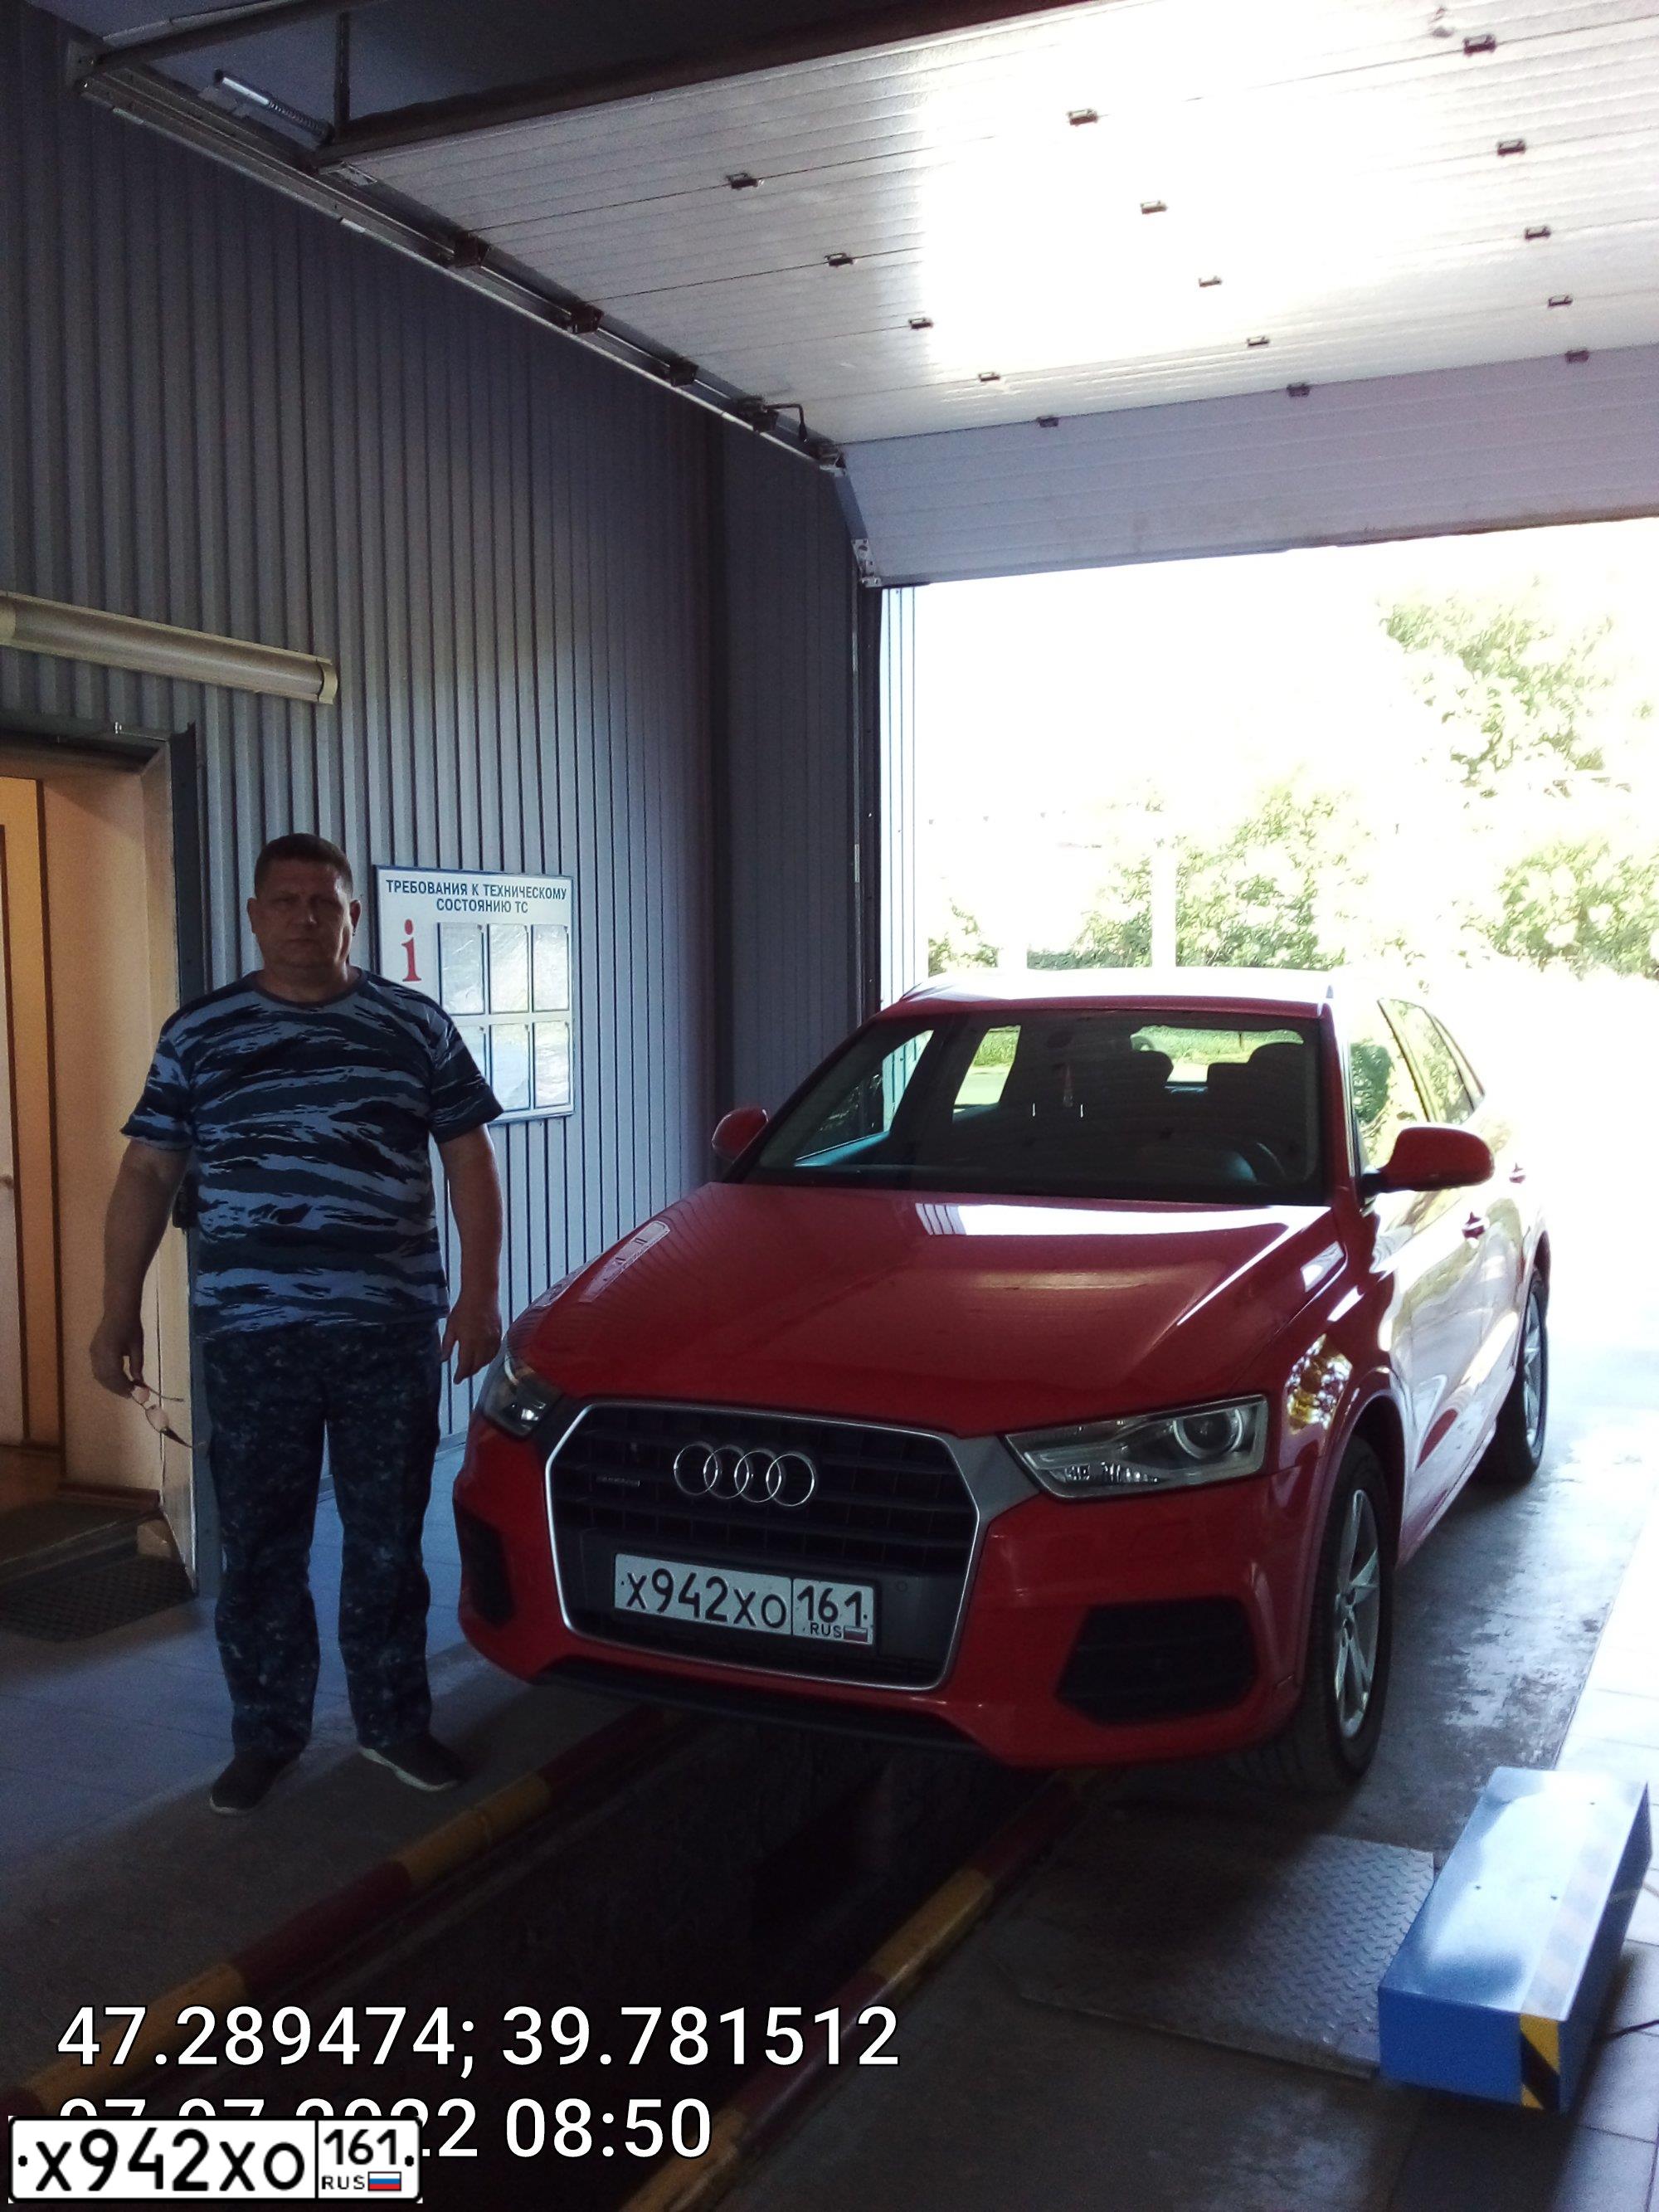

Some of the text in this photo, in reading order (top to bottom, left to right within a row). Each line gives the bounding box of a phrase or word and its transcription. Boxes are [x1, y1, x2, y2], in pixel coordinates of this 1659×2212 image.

[386, 879, 567, 900] ТРЕБОВАНИЯ К ТЕХНИЧЕСКОМУ
[436, 898, 529, 914] СОСТОЯНИЮ ТС
[796, 1584, 863, 1628] 161
[810, 1621, 843, 1640] RUS
